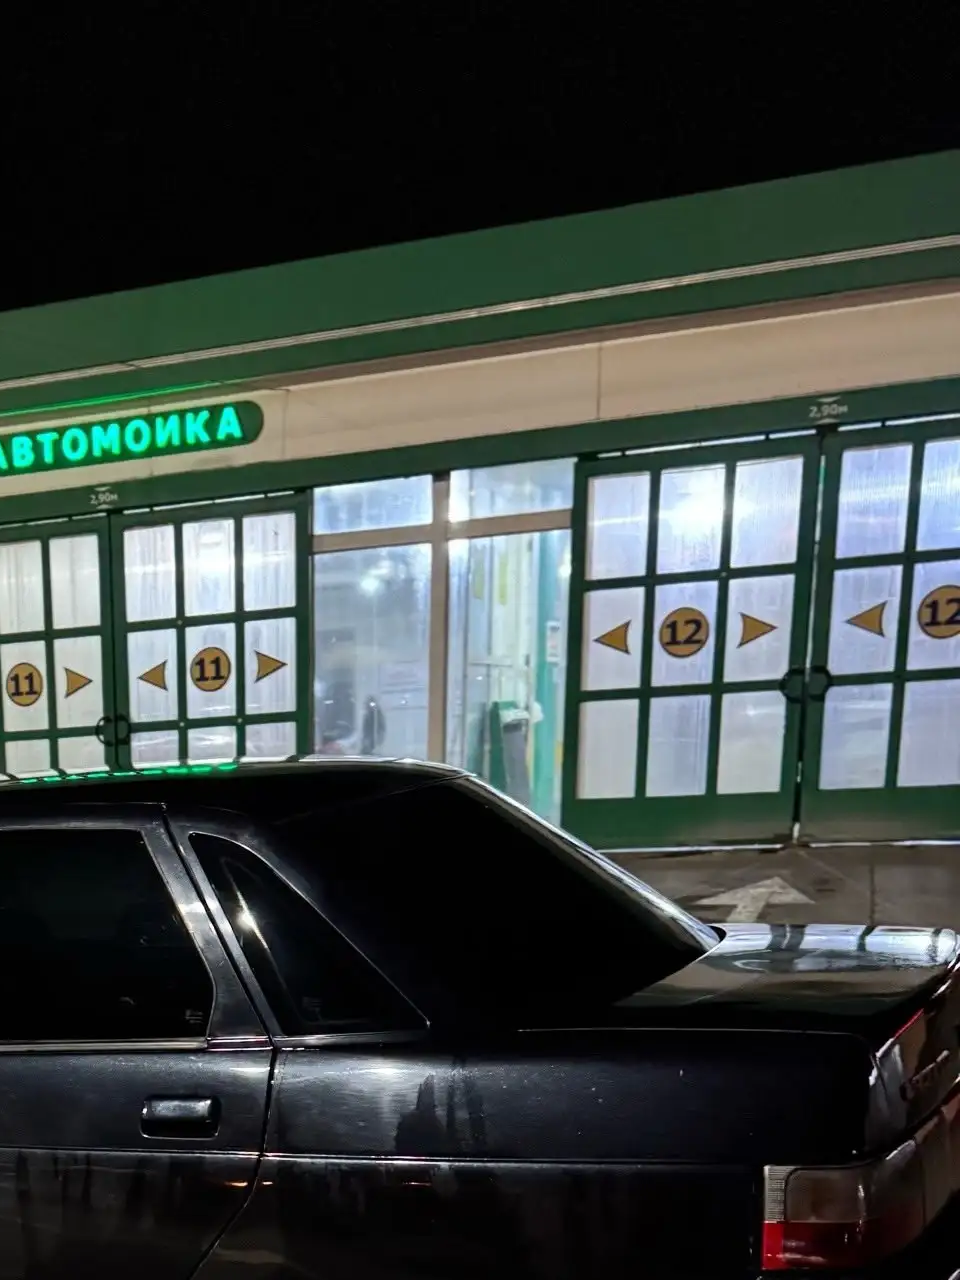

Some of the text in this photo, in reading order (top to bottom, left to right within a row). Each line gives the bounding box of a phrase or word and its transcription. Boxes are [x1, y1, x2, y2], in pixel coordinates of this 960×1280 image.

[924, 597, 960, 626] 12
[665, 619, 702, 645] 12
[194, 656, 226, 682] 11
[10, 672, 39, 697] 11
